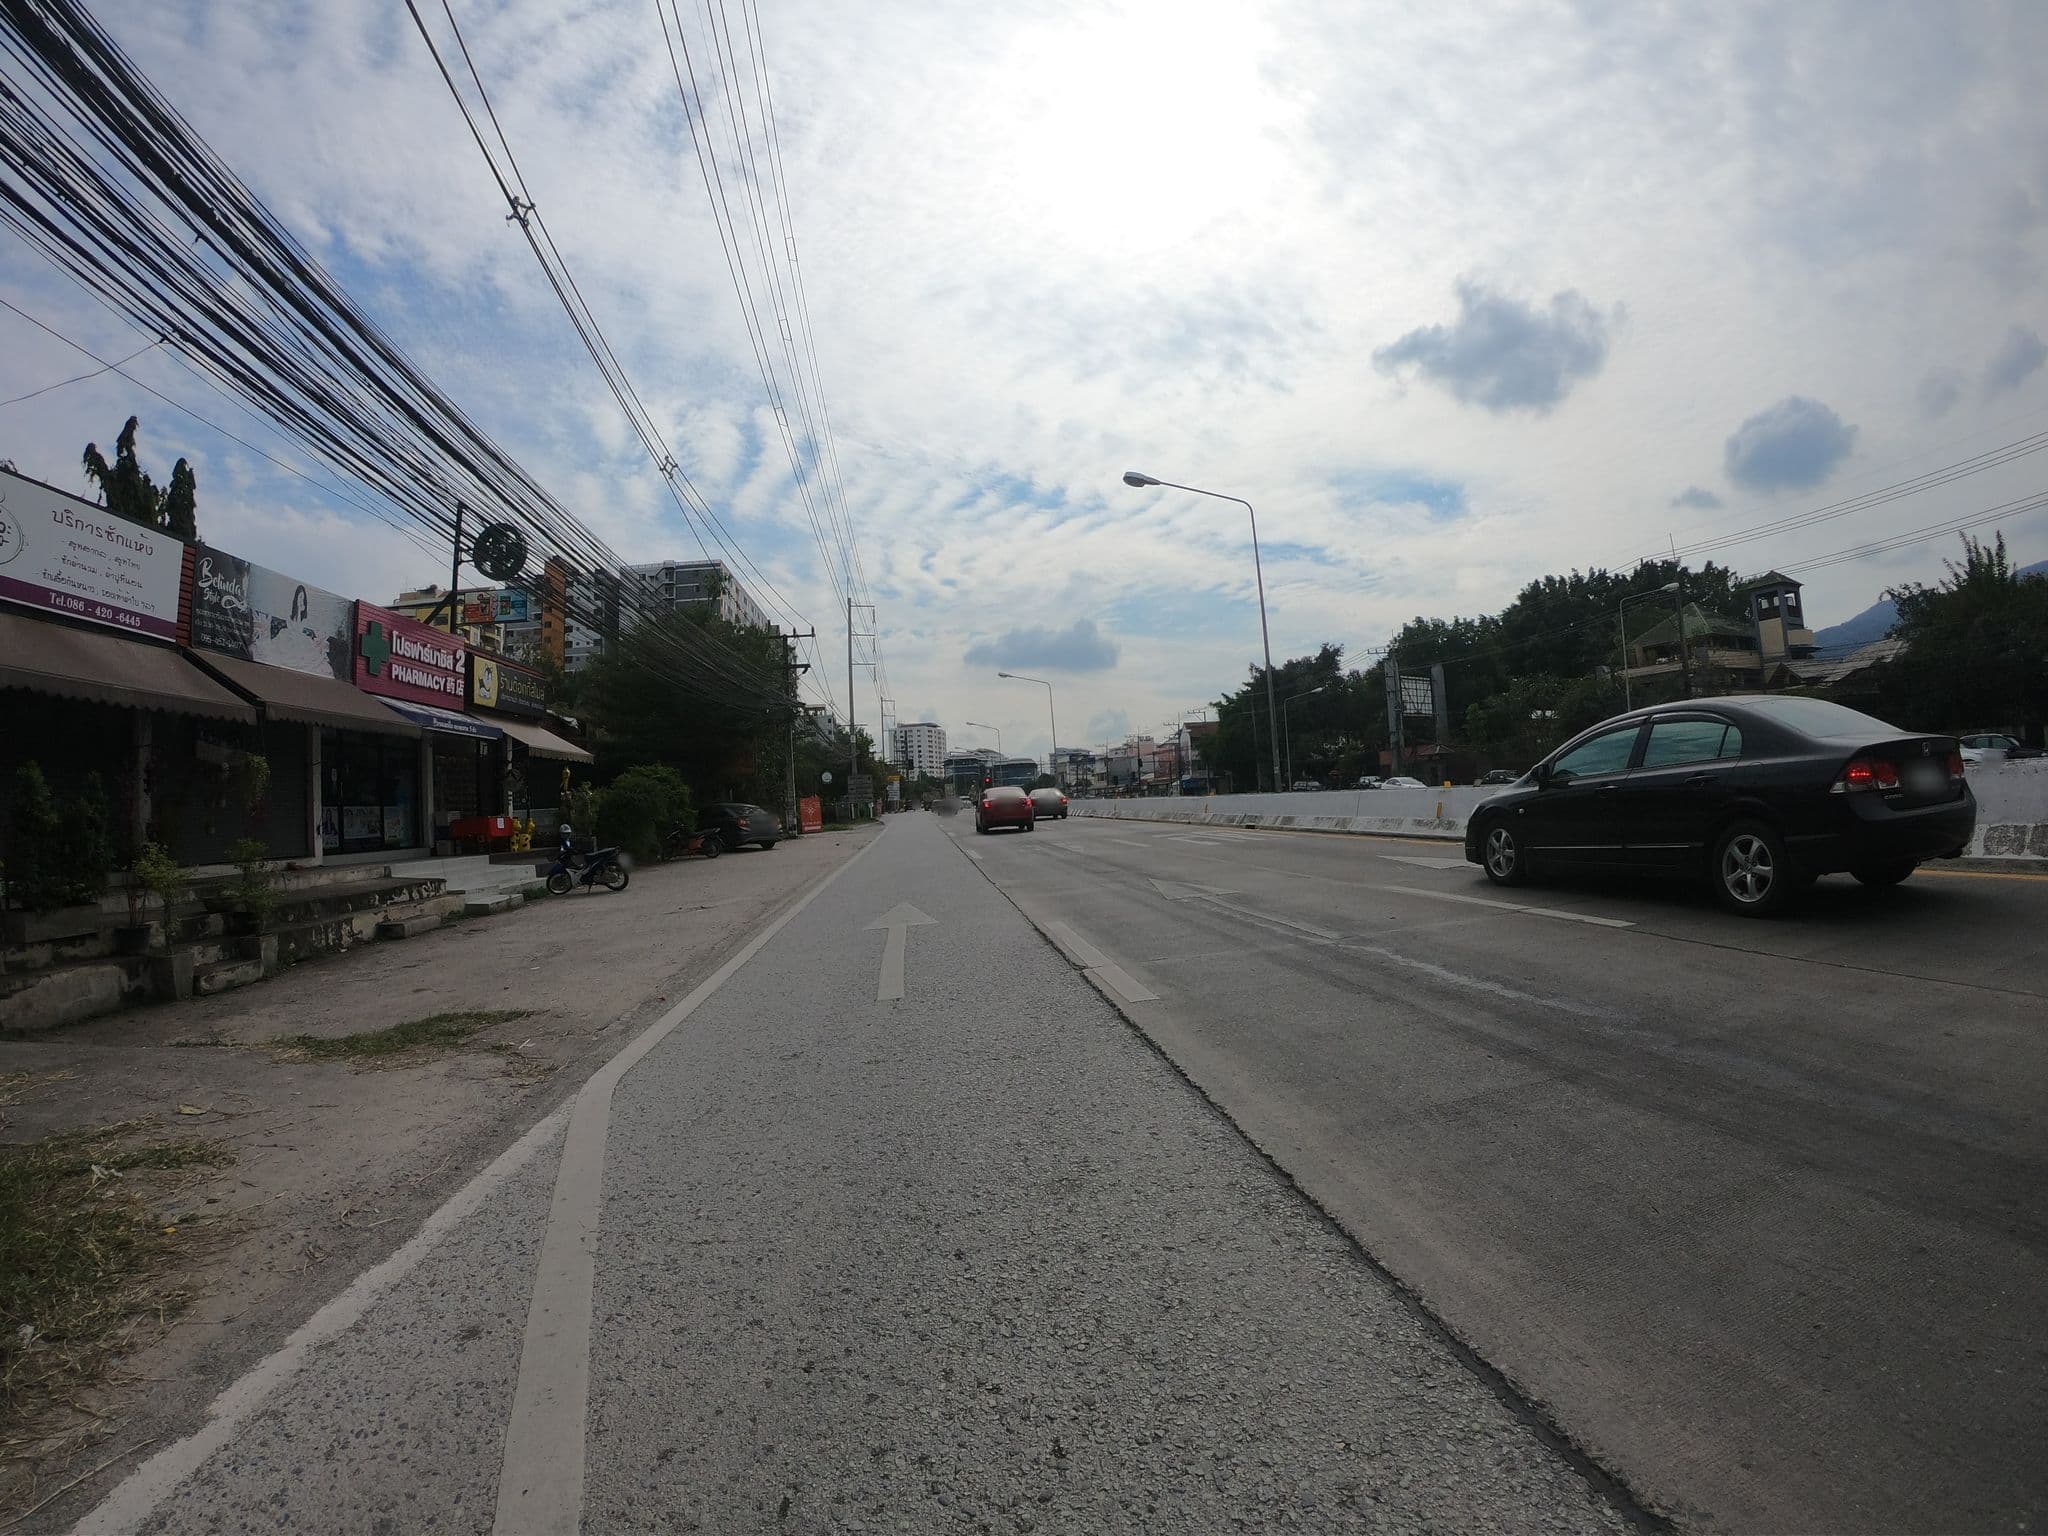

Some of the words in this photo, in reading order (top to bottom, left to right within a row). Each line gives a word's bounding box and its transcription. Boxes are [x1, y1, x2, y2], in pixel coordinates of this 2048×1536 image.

[52, 509, 154, 556] บริการซักแห้ง
[198, 556, 241, 596] Belinda
[50, 591, 85, 612] Tel.086
[95, 606, 113, 620] 420
[455, 648, 466, 674] 2
[391, 663, 446, 692] PHARMACY
